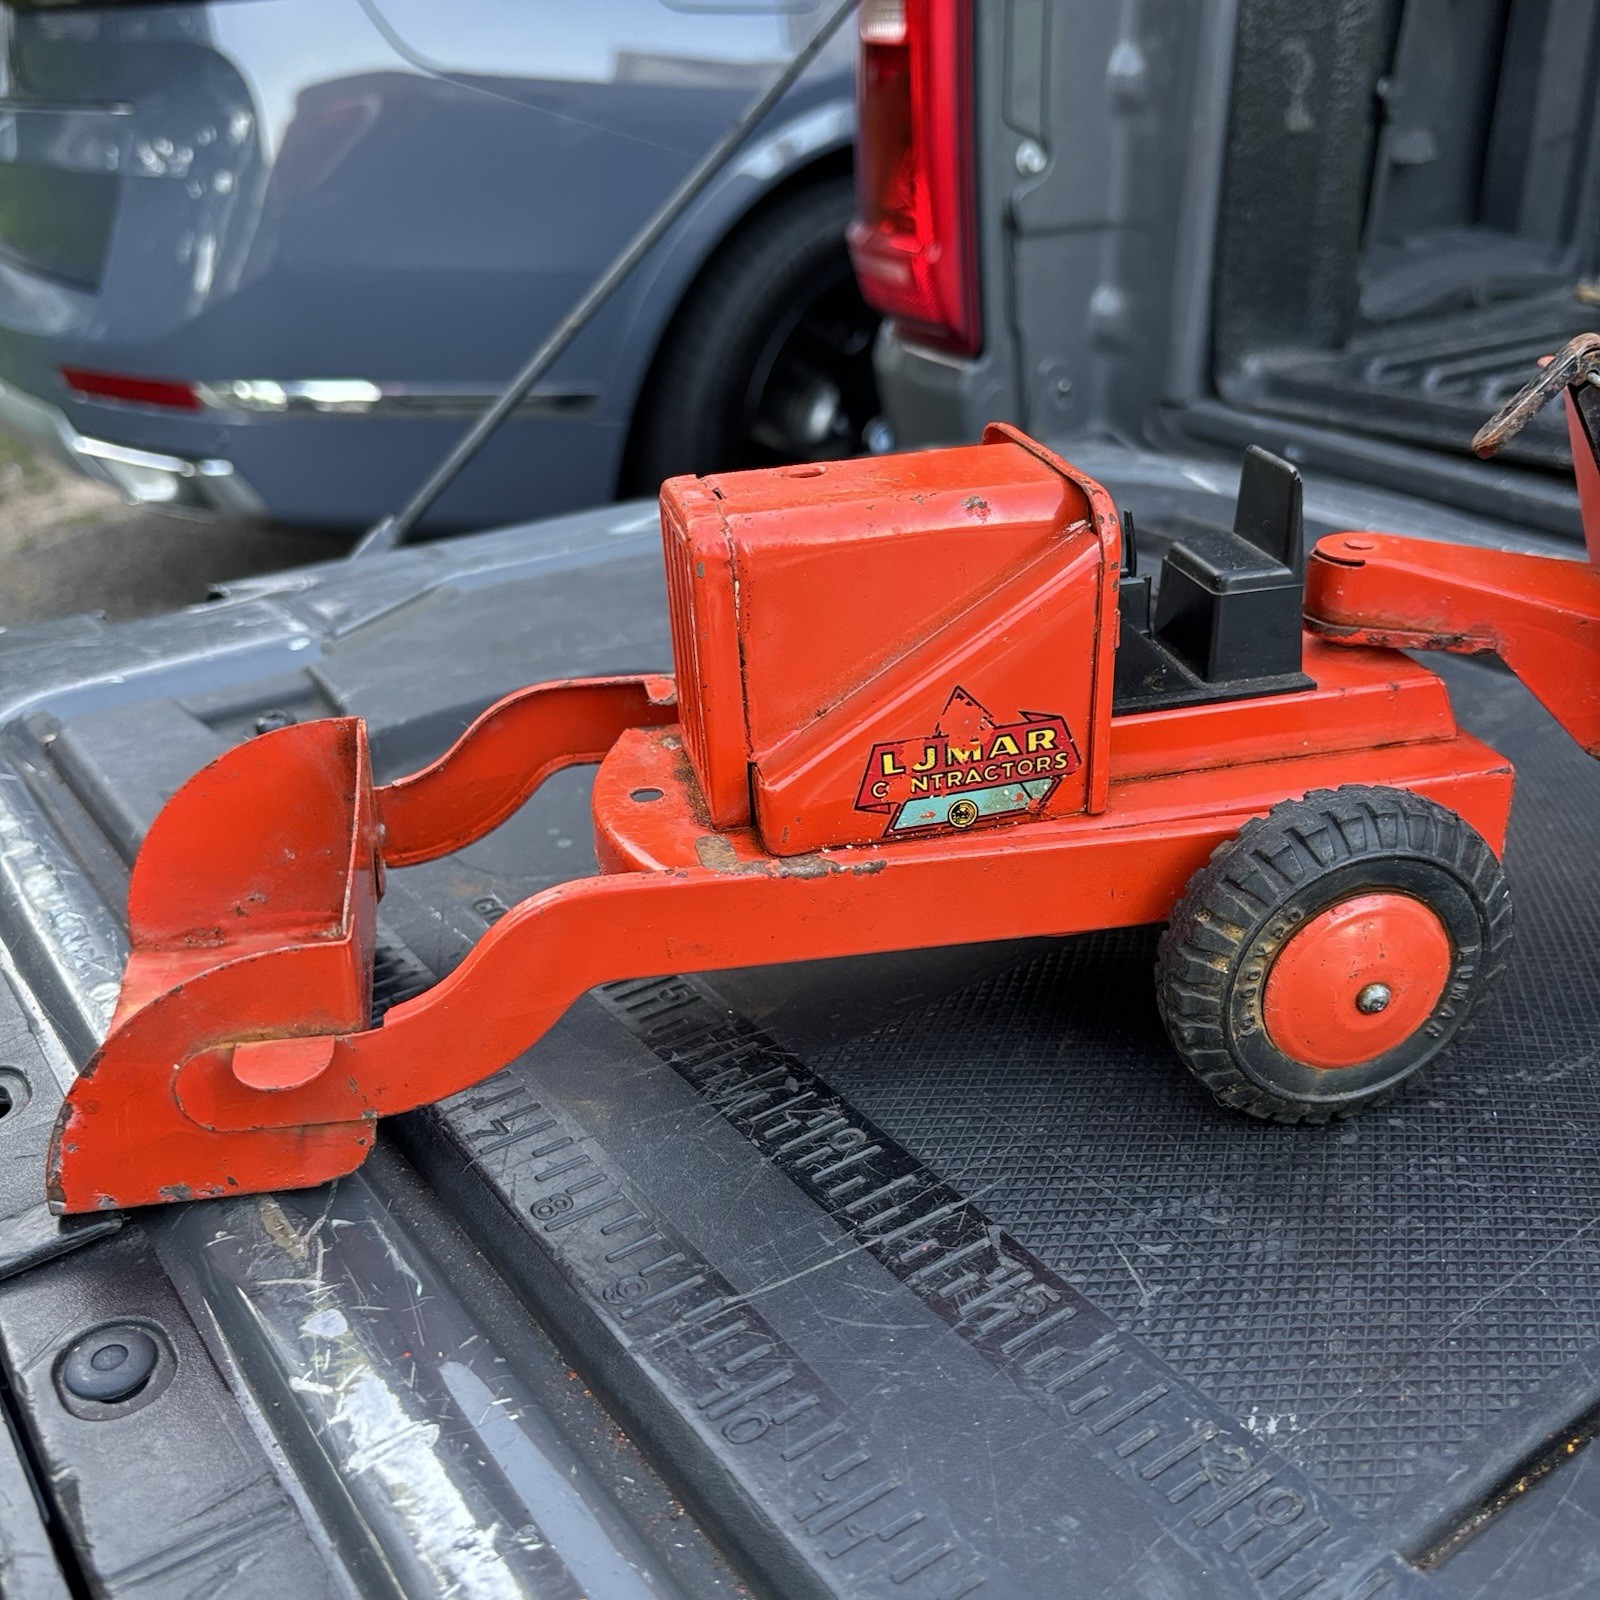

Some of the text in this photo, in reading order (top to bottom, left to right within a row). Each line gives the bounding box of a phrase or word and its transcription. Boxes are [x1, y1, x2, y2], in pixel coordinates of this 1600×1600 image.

[872, 752, 1068, 799] CNTRACTORS
[470, 1117, 511, 1141] 7
[530, 1194, 574, 1221] 8
[603, 1275, 649, 1305] 9
[697, 1380, 770, 1444] 10
[1200, 1443, 1304, 1525] 20
